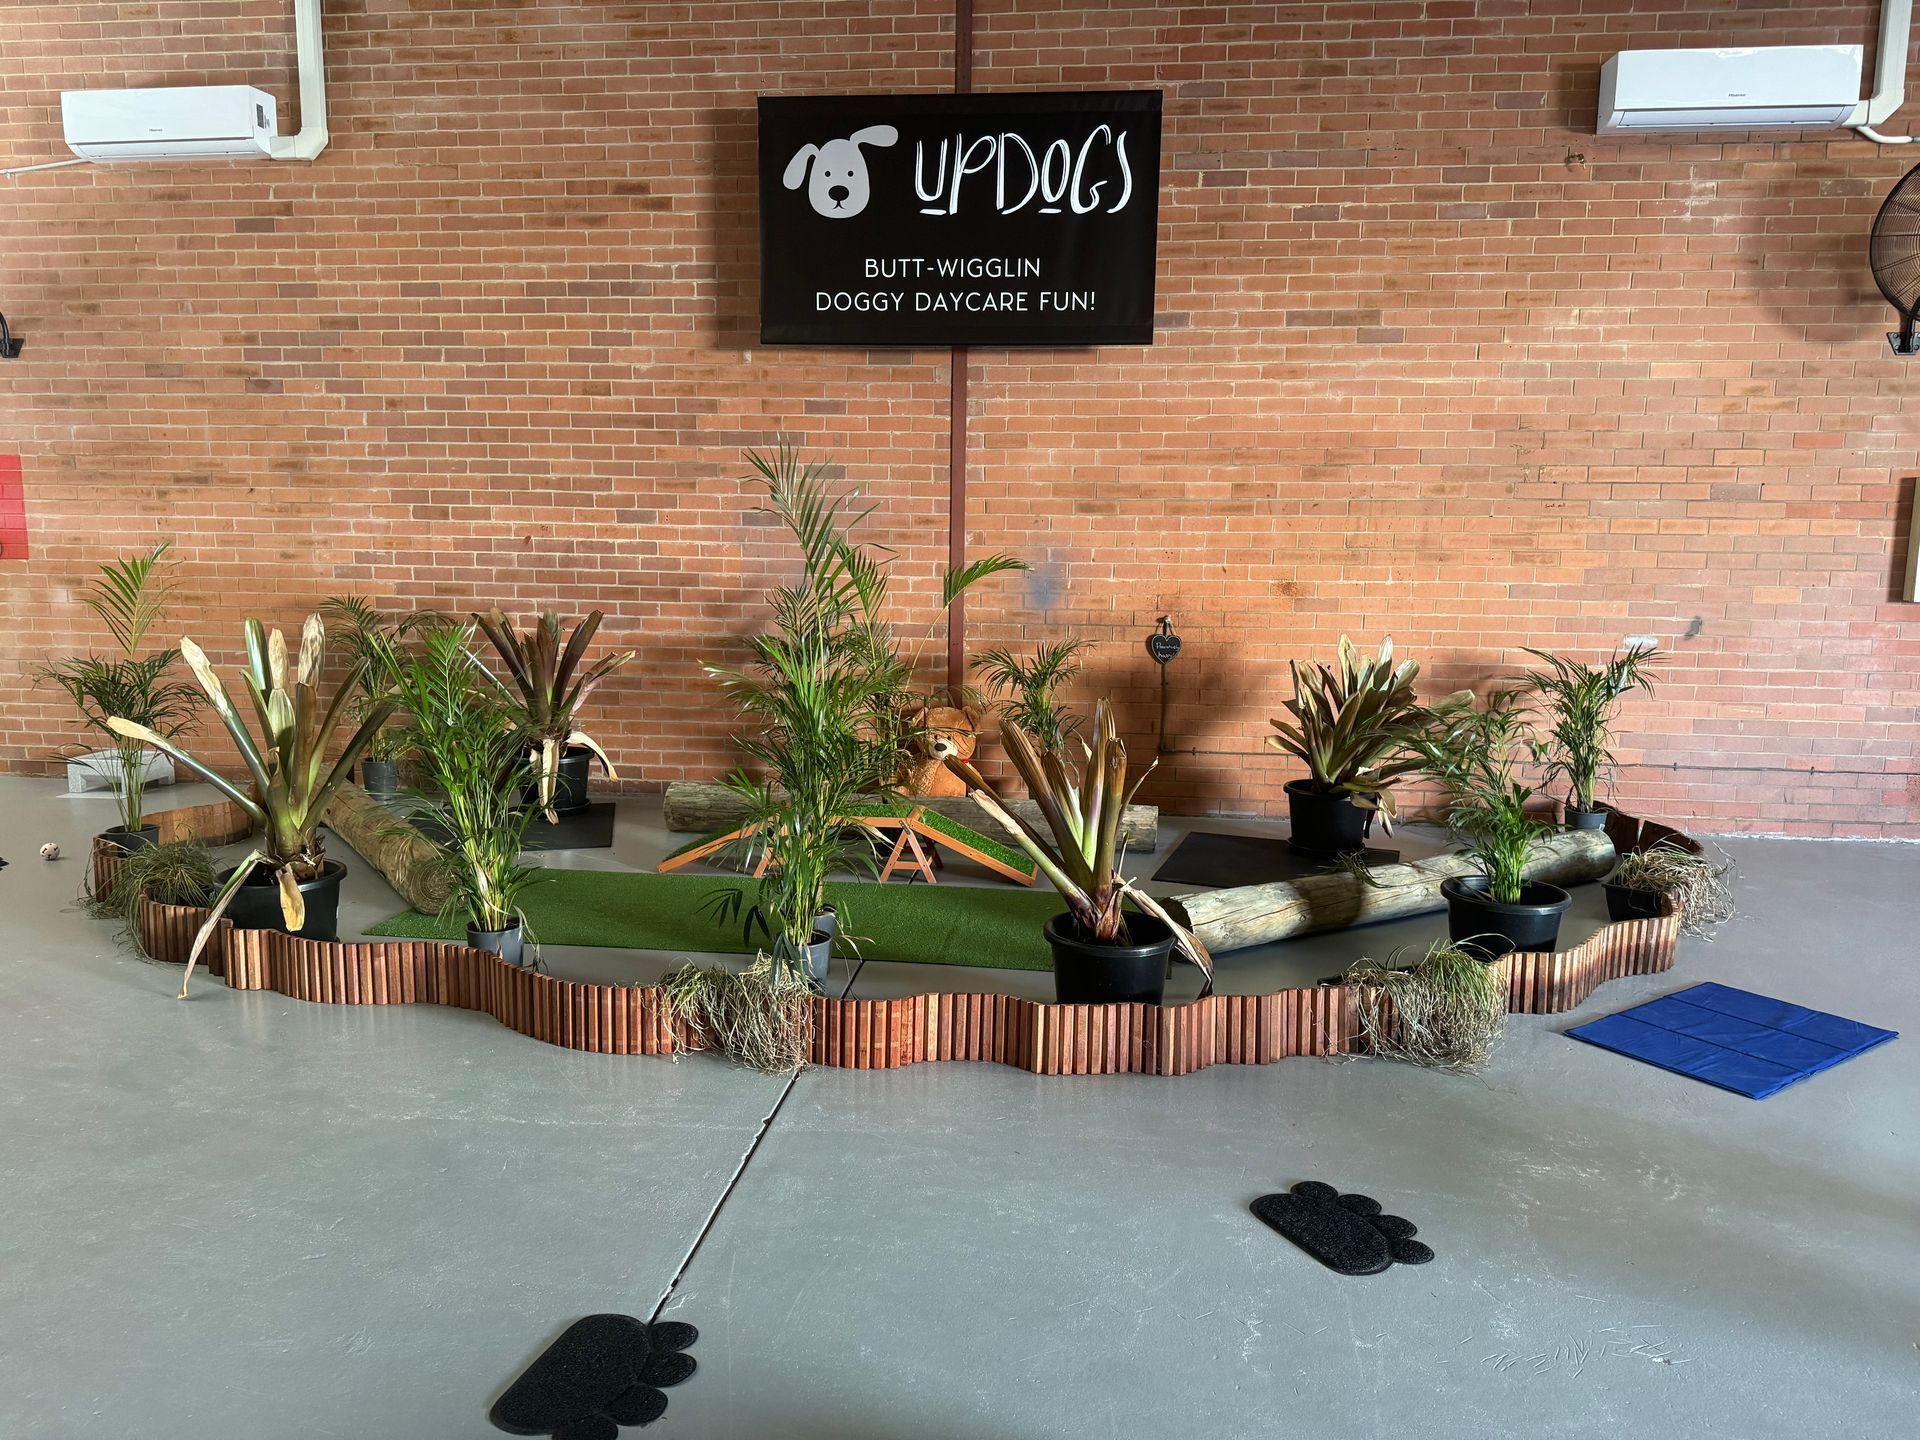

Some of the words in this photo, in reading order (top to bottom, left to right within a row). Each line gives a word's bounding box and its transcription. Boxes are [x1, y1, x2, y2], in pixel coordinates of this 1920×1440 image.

[914, 123, 1133, 216] UPDOGS
[864, 257, 1041, 278] BUTT-WIGGLIN
[815, 291, 905, 312] DOGGY
[915, 291, 1029, 312] DAYCARE
[1039, 291, 1096, 312] FUN!
